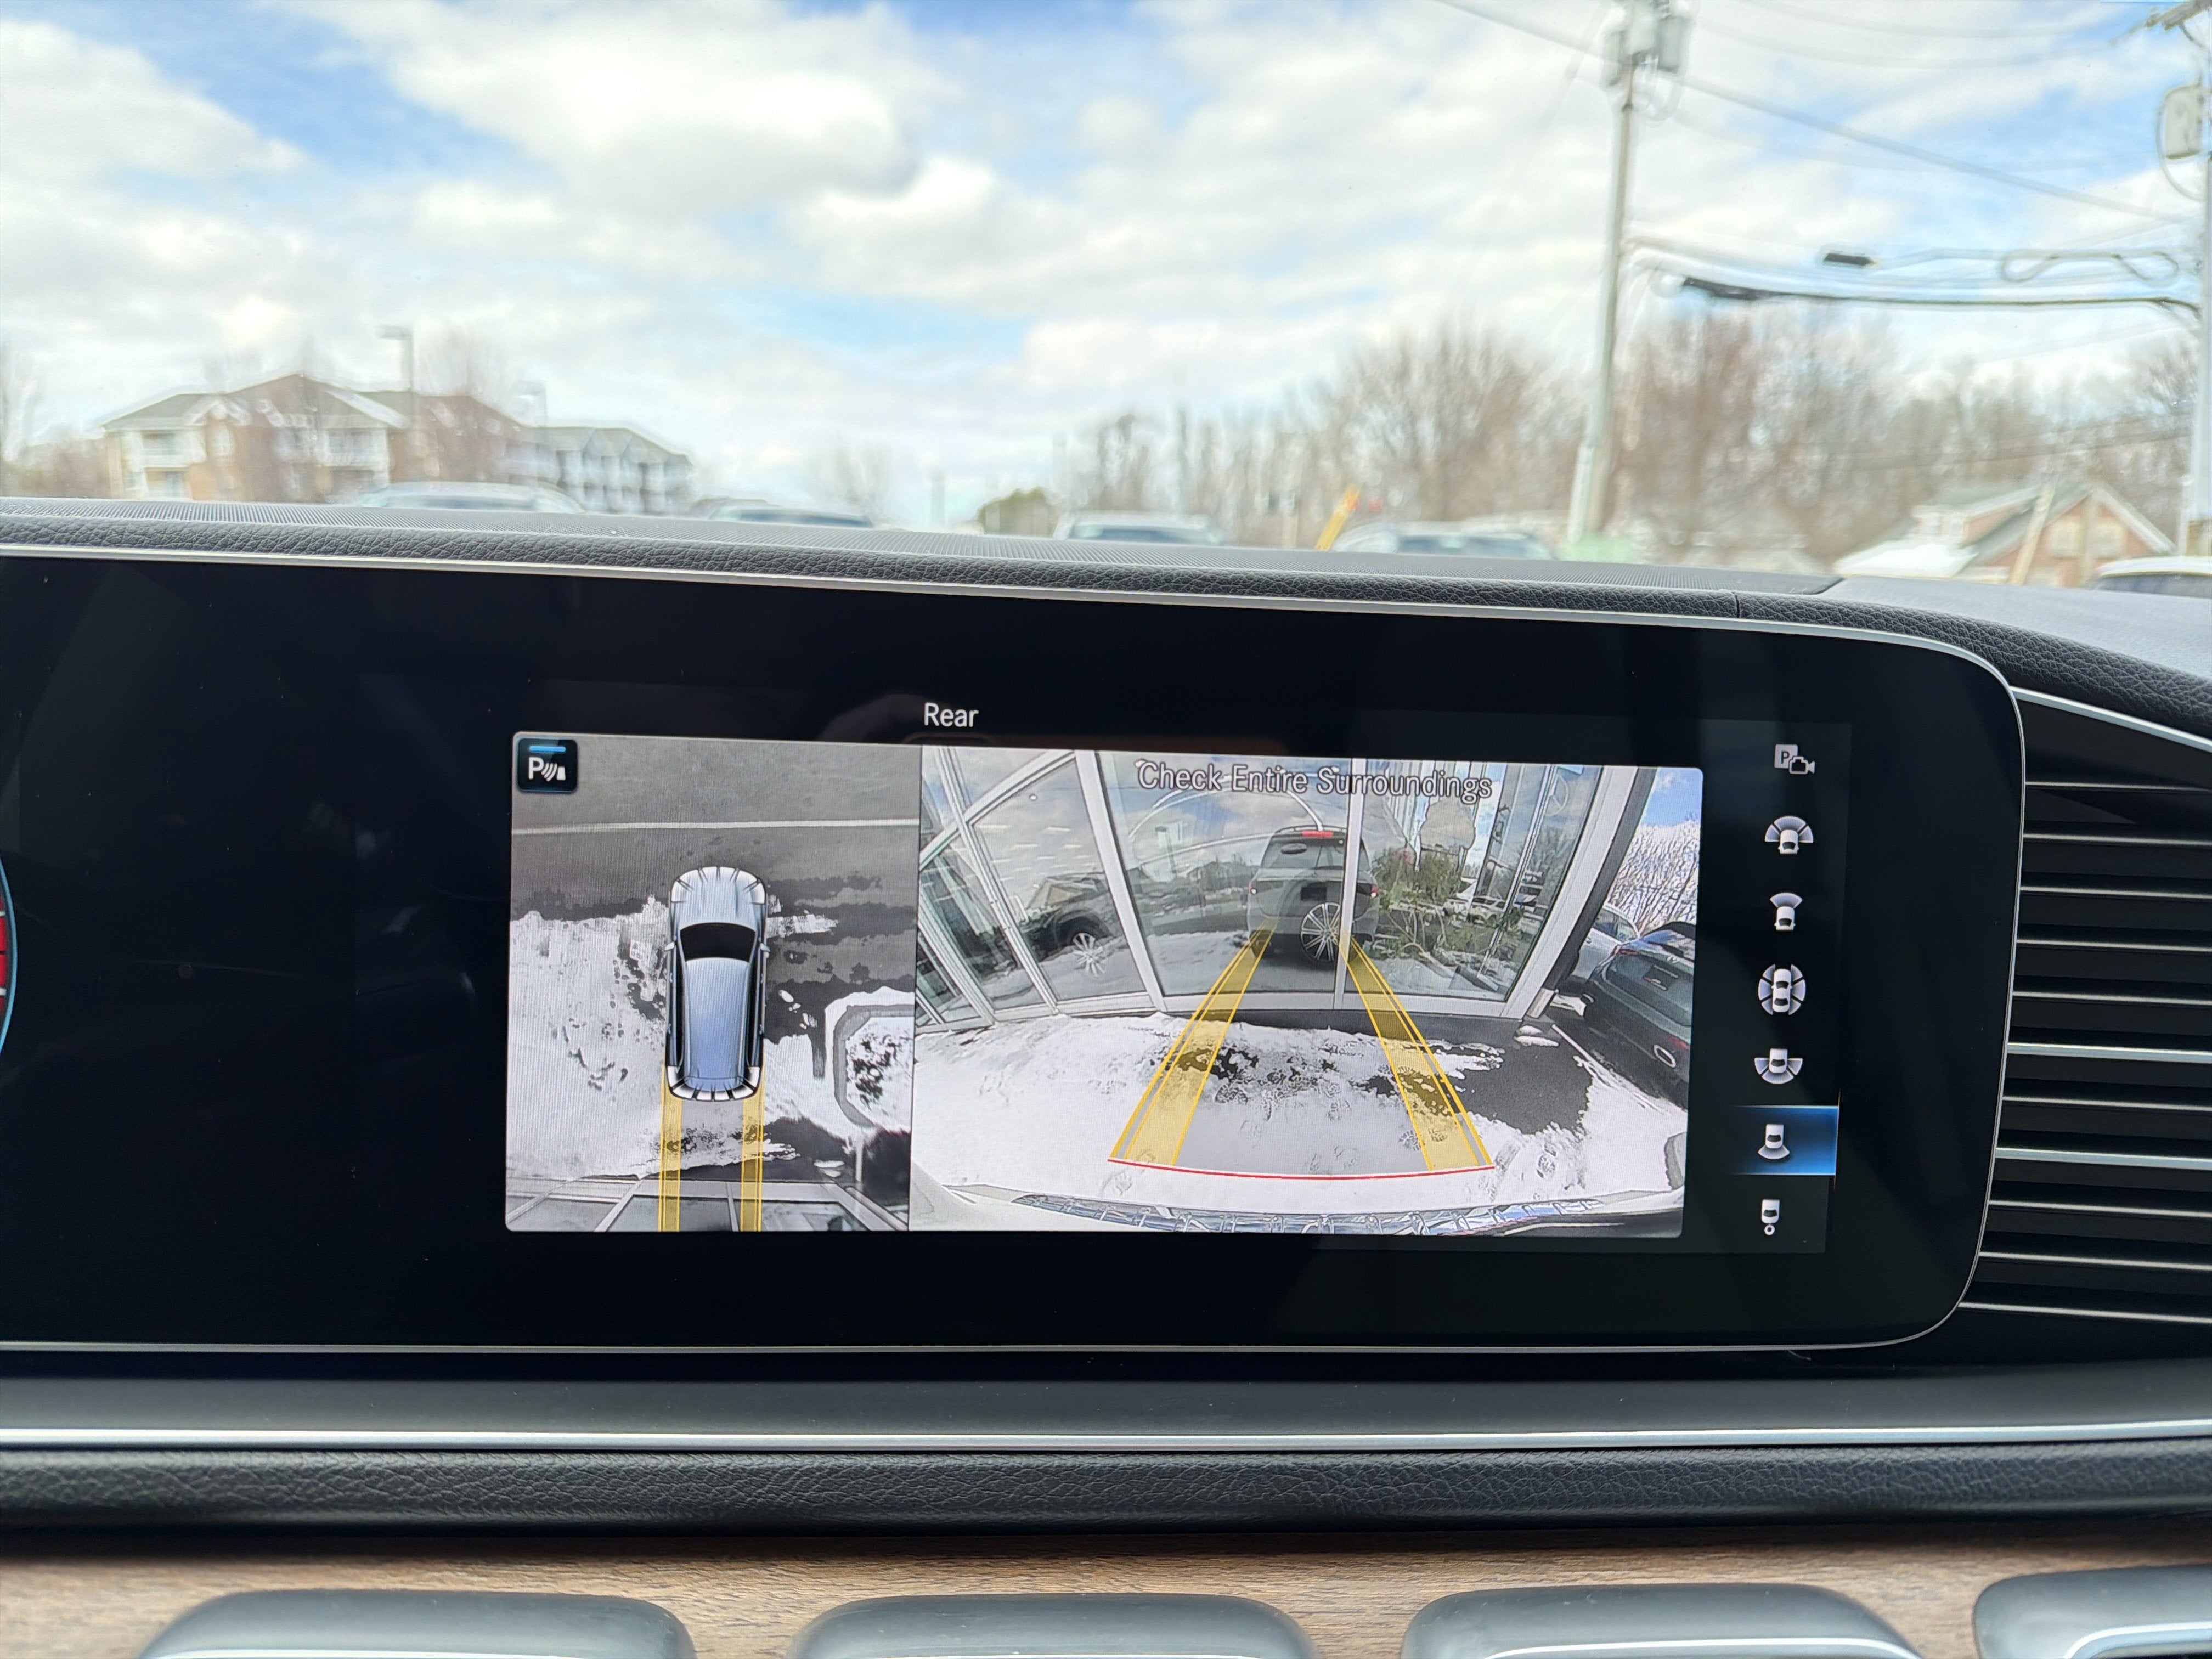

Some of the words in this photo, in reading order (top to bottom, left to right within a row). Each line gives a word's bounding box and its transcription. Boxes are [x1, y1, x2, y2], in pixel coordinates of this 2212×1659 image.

[923, 702, 979, 727] Rear
[528, 757, 544, 780] P
[1781, 751, 1790, 764] P
[1138, 761, 1222, 791] Check
[1231, 764, 1308, 793] Entire
[1317, 766, 1492, 804] Surroundings
